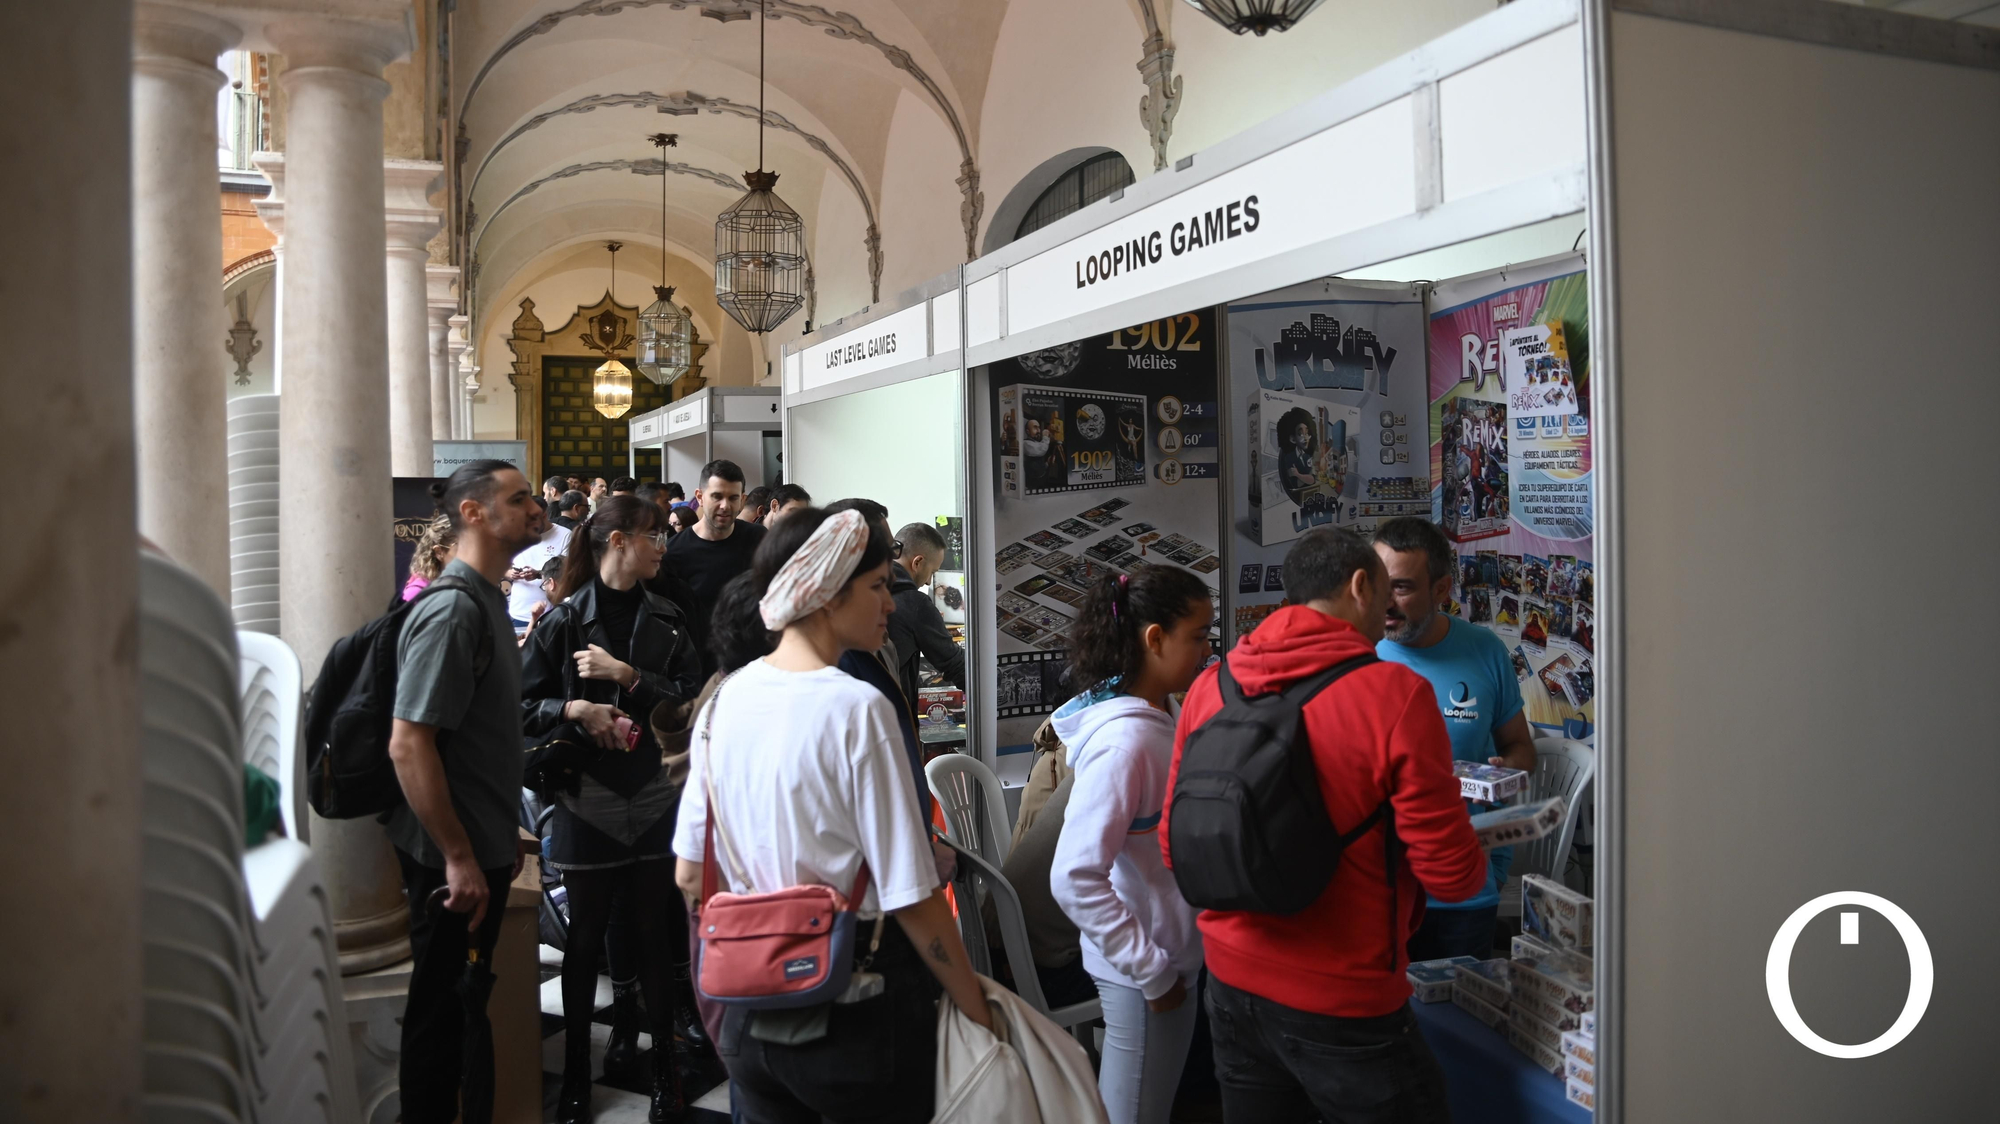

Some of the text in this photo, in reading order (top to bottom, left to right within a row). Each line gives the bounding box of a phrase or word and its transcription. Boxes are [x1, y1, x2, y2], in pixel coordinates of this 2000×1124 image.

[1076, 195, 1260, 289] LOOPING GAMES
[1493, 302, 1519, 322] MARVEL
[826, 332, 896, 369] LAST LEVEL GAMES
[1518, 342, 1547, 357] TORNEO!
[1127, 354, 1177, 370] Méliès
[1183, 404, 1203, 415] 2-4
[1461, 417, 1505, 451] REMIX
[1070, 450, 1112, 472] 1902
[1081, 471, 1103, 481] Méliès
[1185, 465, 1206, 476] 12+
[1537, 483, 1567, 492] SUPEREQUIPO
[1567, 484, 1574, 492] DE
[1574, 484, 1588, 492] CARTA
[1519, 495, 1525, 503] EN
[1525, 495, 1539, 503] CARTA
[1539, 495, 1551, 503] PARA
[1552, 495, 1575, 503] DERROTAR
[1579, 495, 1588, 503] LOS
[1292, 493, 1344, 533] URBIFY
[1524, 506, 1544, 514] VILLANOS
[1533, 518, 1555, 526] UNIVERSO
[1444, 707, 1479, 720] Looping
[1556, 898, 1576, 918] 1980
[1545, 981, 1566, 999] 1980
